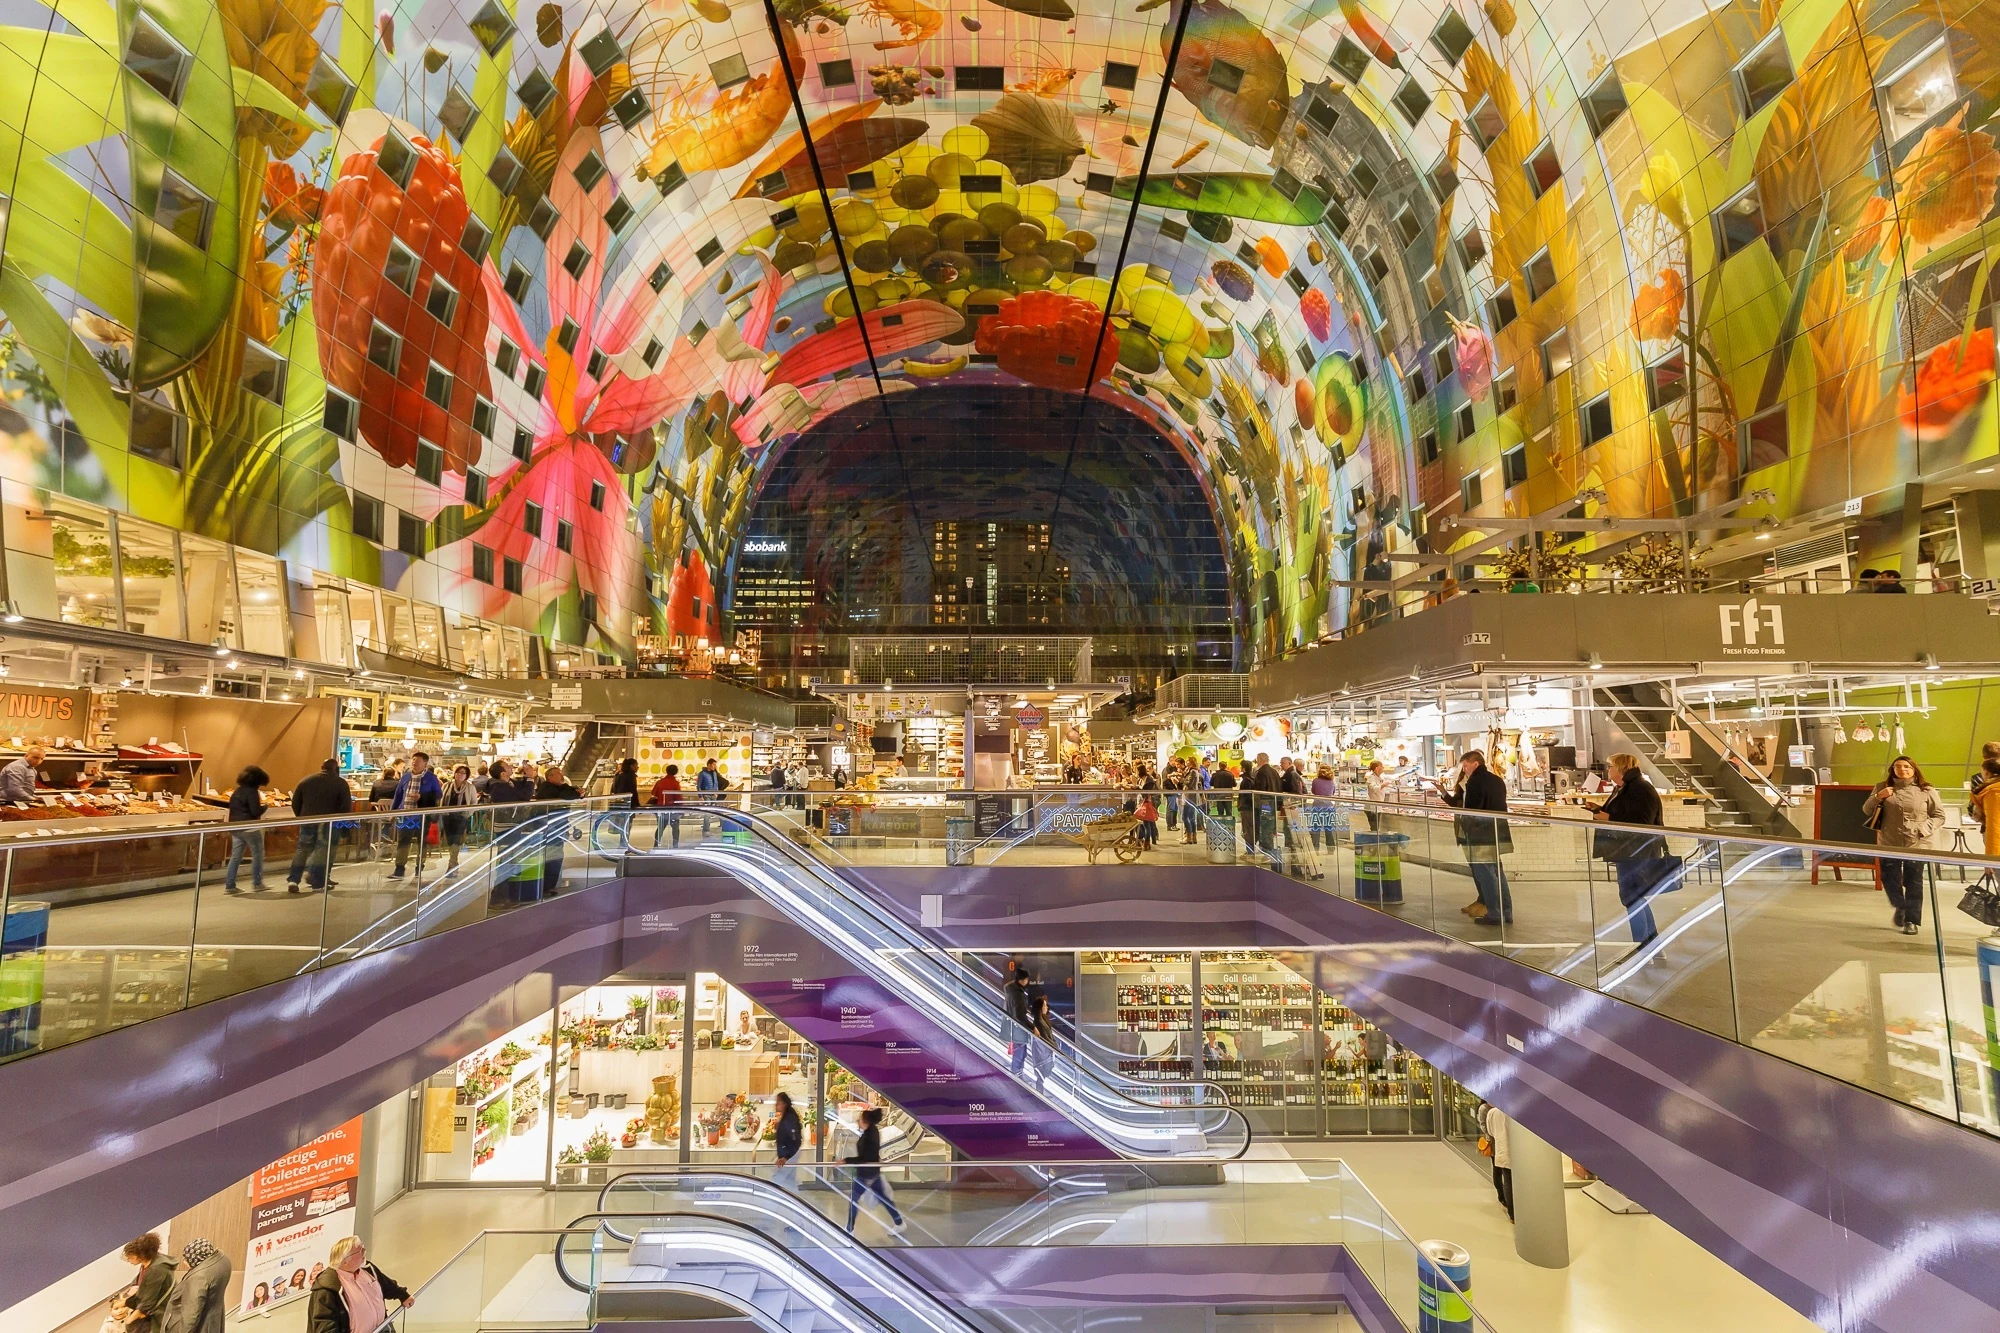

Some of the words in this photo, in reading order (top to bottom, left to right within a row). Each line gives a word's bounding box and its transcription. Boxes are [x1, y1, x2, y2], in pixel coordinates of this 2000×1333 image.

[743, 541, 787, 552] abobank
[1972, 579, 1997, 594] 21
[1474, 633, 1490, 643] 17
[8, 693, 73, 720] NUTS
[1053, 813, 1102, 828] PATAT
[1140, 974, 1156, 983] Gall
[1160, 974, 1175, 983] Gall
[1223, 974, 1238, 983] Gall
[1242, 974, 1257, 983] Gall
[840, 1006, 857, 1014] 1940
[968, 1103, 985, 1111] 1900
[302, 1129, 347, 1148] hone,
[260, 1152, 355, 1187] toiletervaring
[261, 1149, 318, 1176] prettige
[258, 1202, 294, 1219] Korting
[294, 1197, 306, 1208] bij
[257, 1211, 294, 1230] partners
[276, 1223, 325, 1245] vendor
